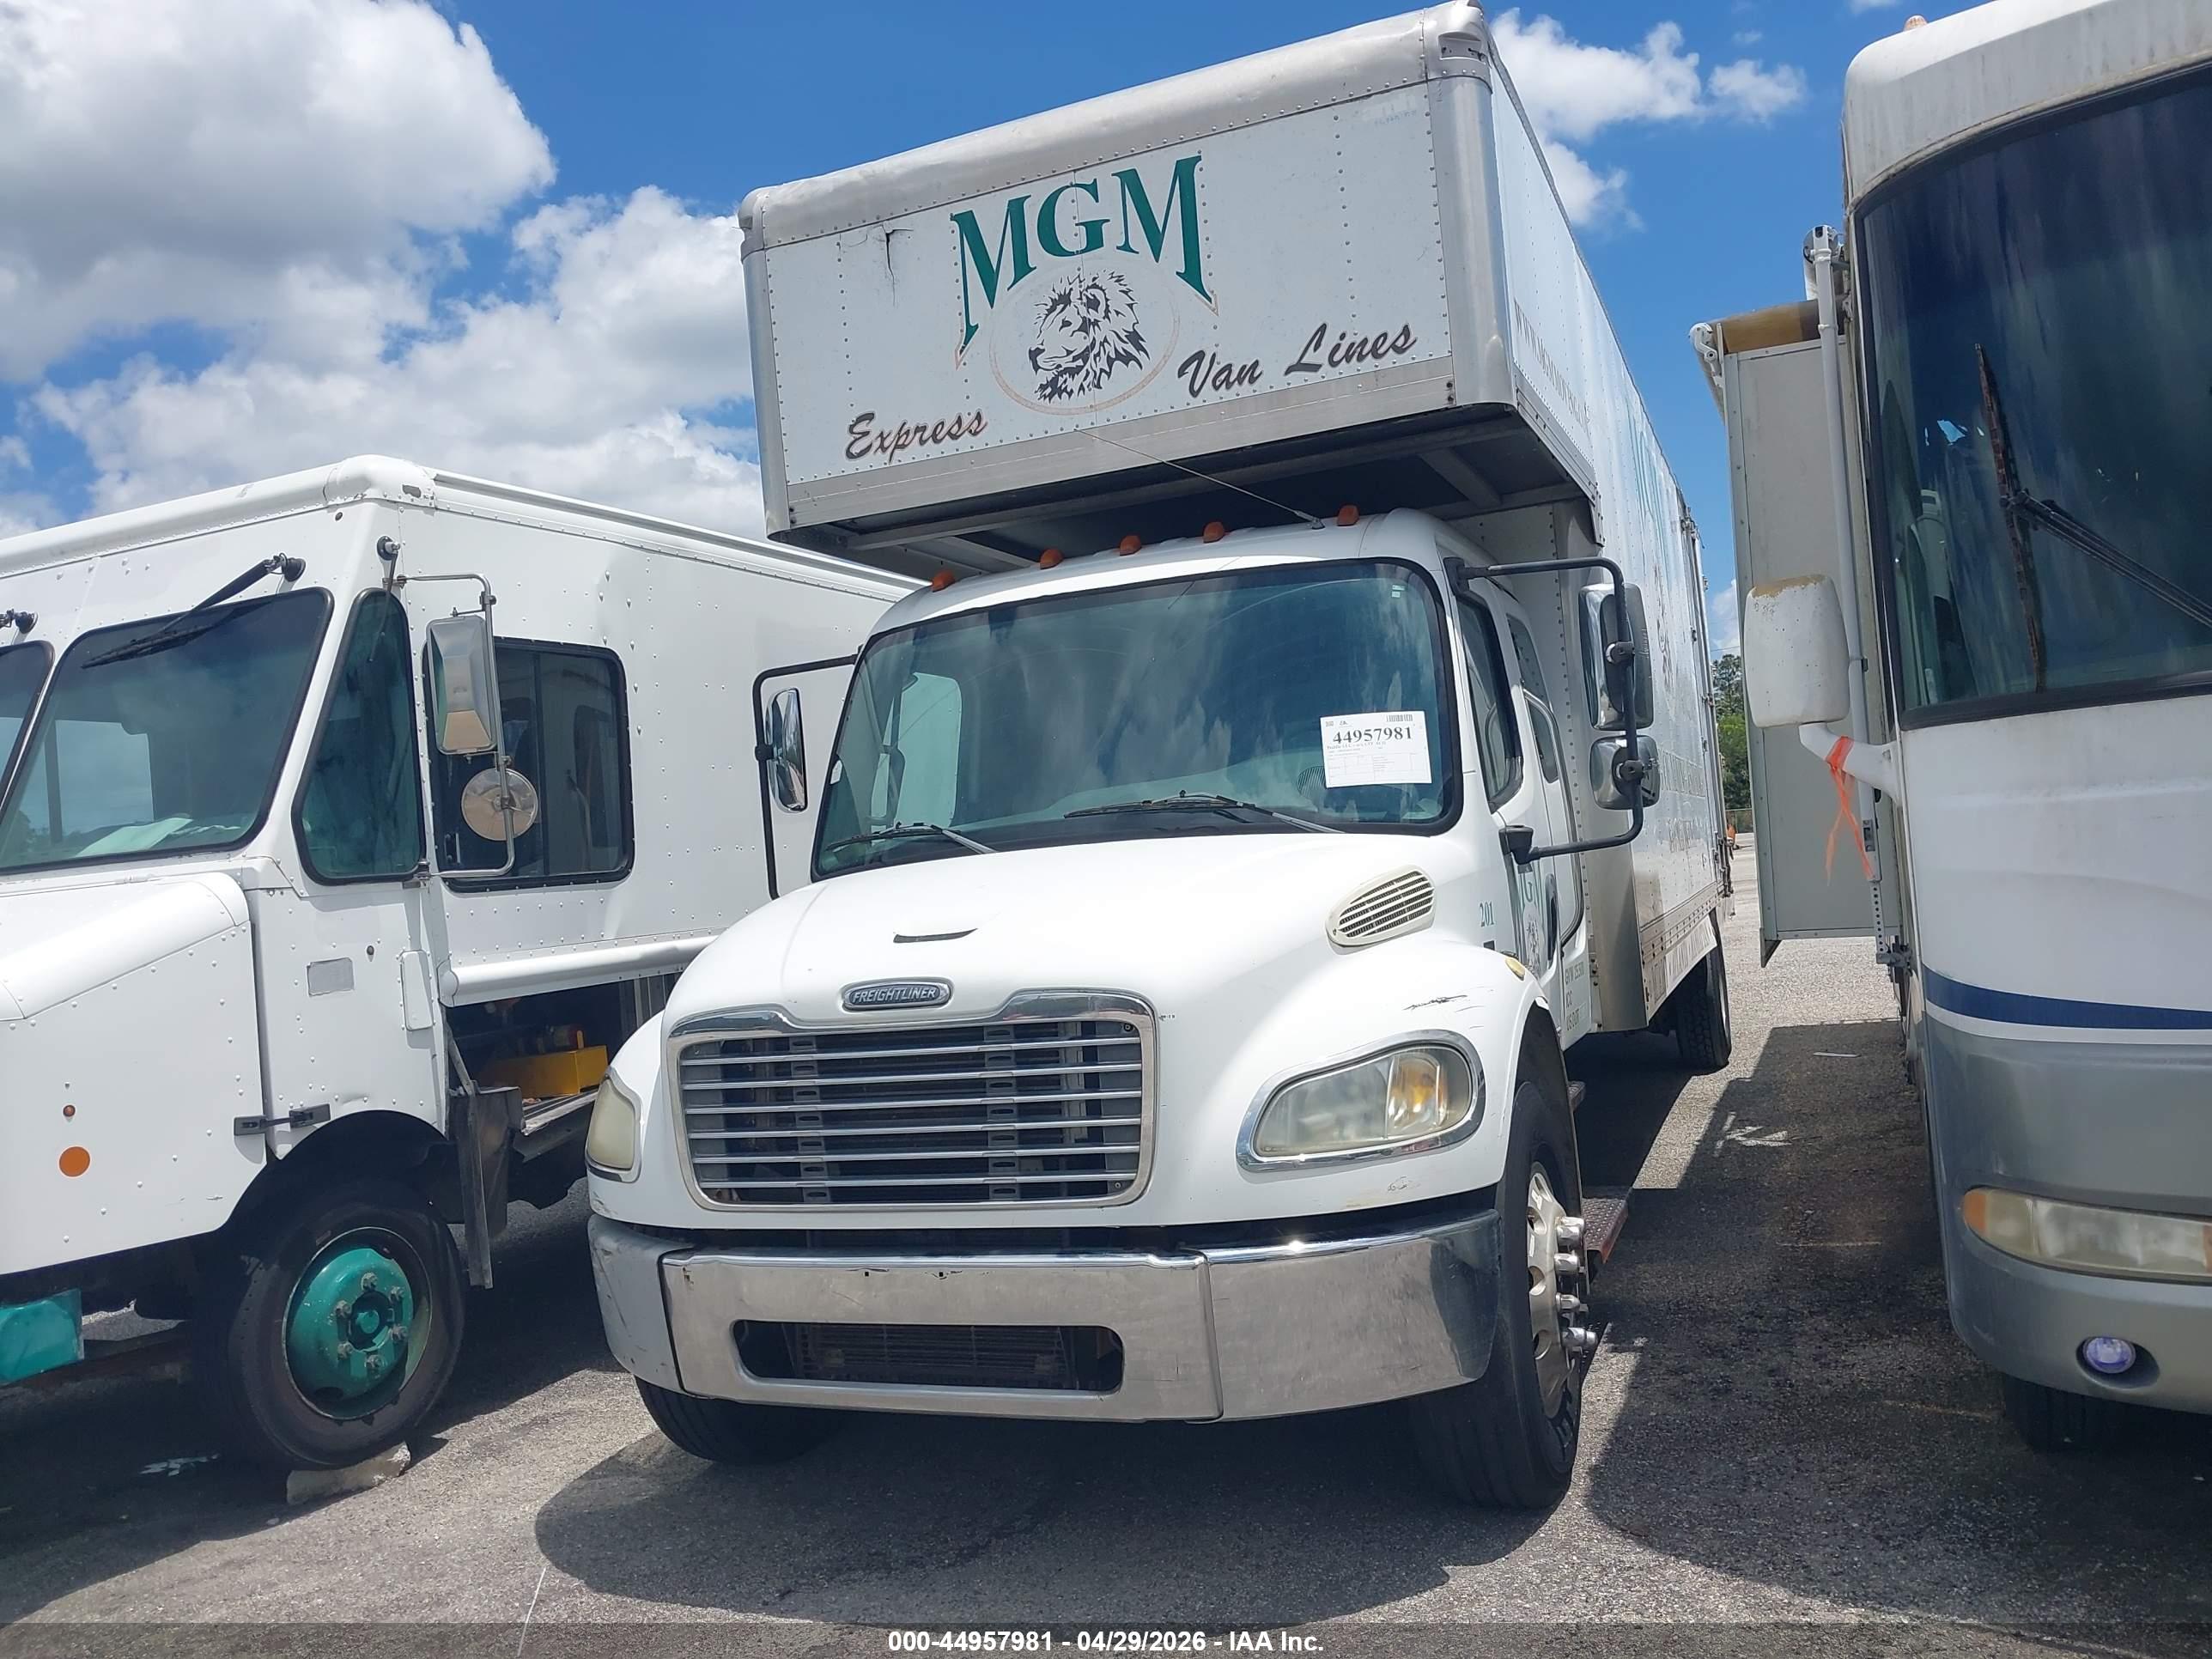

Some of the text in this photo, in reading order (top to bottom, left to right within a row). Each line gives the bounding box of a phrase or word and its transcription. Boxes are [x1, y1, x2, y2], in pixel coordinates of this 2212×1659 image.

[951, 155, 1212, 356] MGM
[843, 322, 1417, 463] Express Van Lines
[1333, 726, 1412, 744] 44957981
[1480, 902, 1495, 927] 201
[852, 988, 936, 1003] FREIGHTLINER
